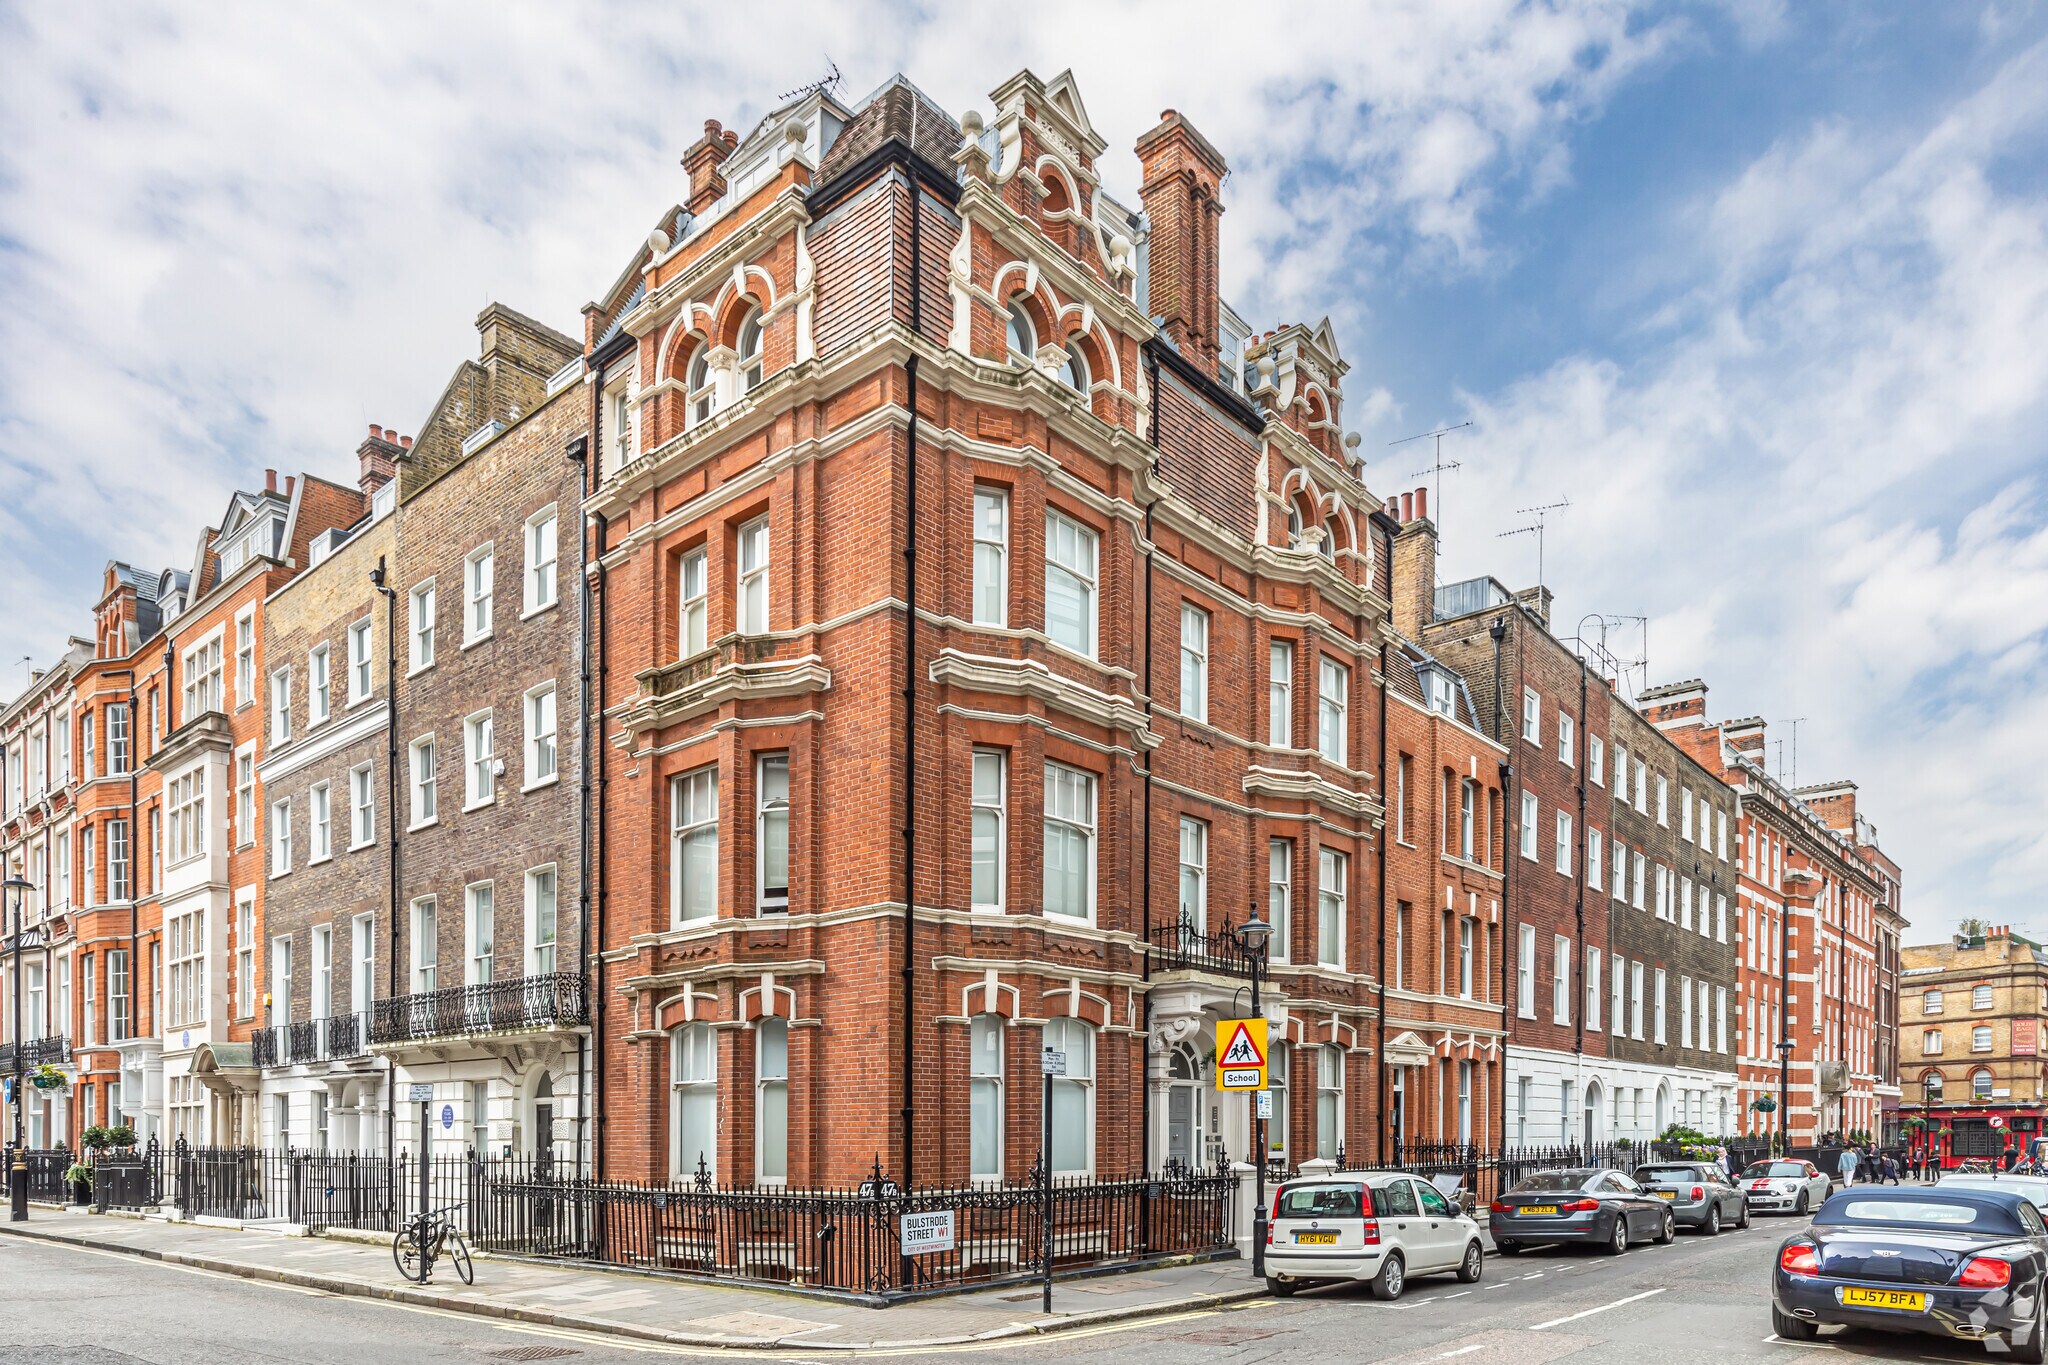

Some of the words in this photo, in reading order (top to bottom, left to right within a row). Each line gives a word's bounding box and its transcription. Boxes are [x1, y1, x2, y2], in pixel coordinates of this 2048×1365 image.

[1227, 1074, 1256, 1082] School
[859, 1183, 875, 1197] 47B
[880, 1183, 897, 1197] 47B
[907, 1215, 948, 1229] BULSTRODE
[907, 1228, 934, 1241] STREET
[937, 1227, 949, 1238] W1
[1300, 1235, 1317, 1243] HY61
[1318, 1235, 1334, 1243] VGU
[921, 1243, 946, 1251] WESTMINSTER
[1850, 1290, 1886, 1303] LJ57
[1889, 1293, 1917, 1306] BFA
